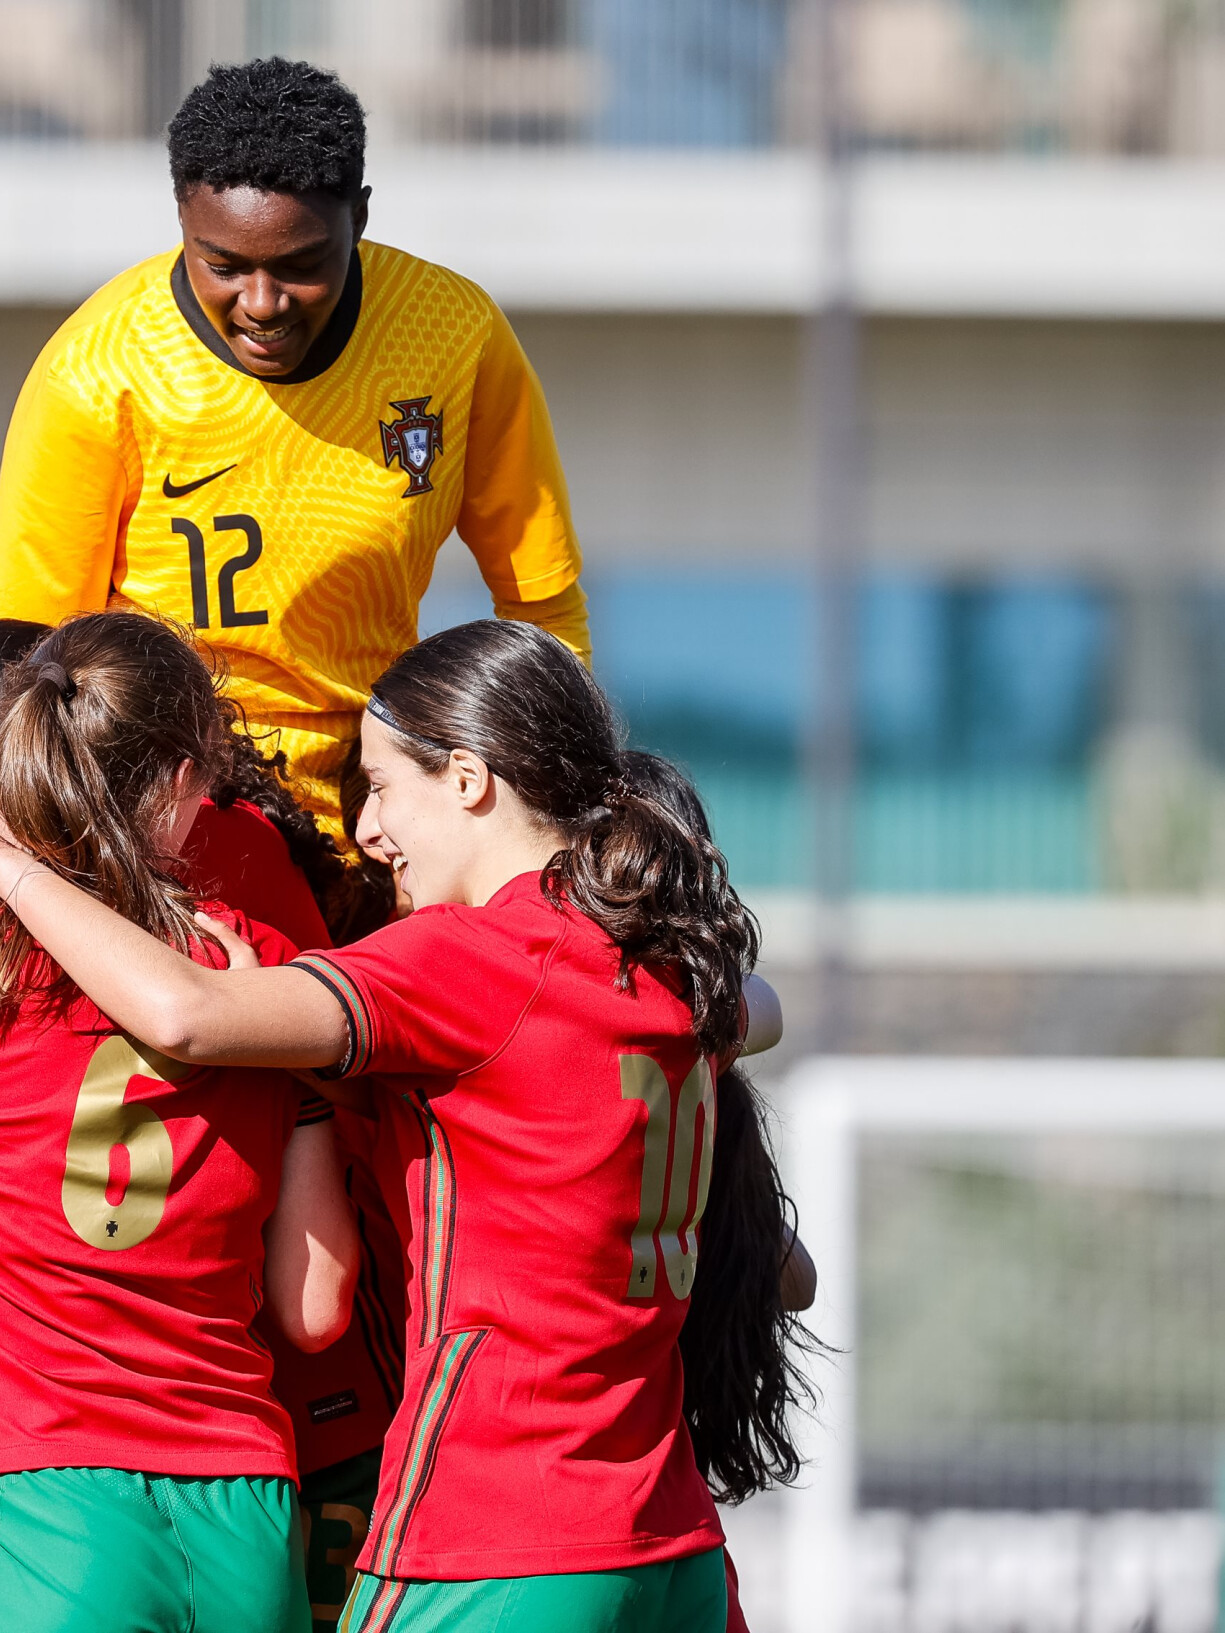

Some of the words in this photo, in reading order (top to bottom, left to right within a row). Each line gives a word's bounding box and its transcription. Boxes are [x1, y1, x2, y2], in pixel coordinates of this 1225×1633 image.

[171, 514, 269, 629] 12
[62, 1035, 191, 1251] 6
[618, 1053, 715, 1300] 10
